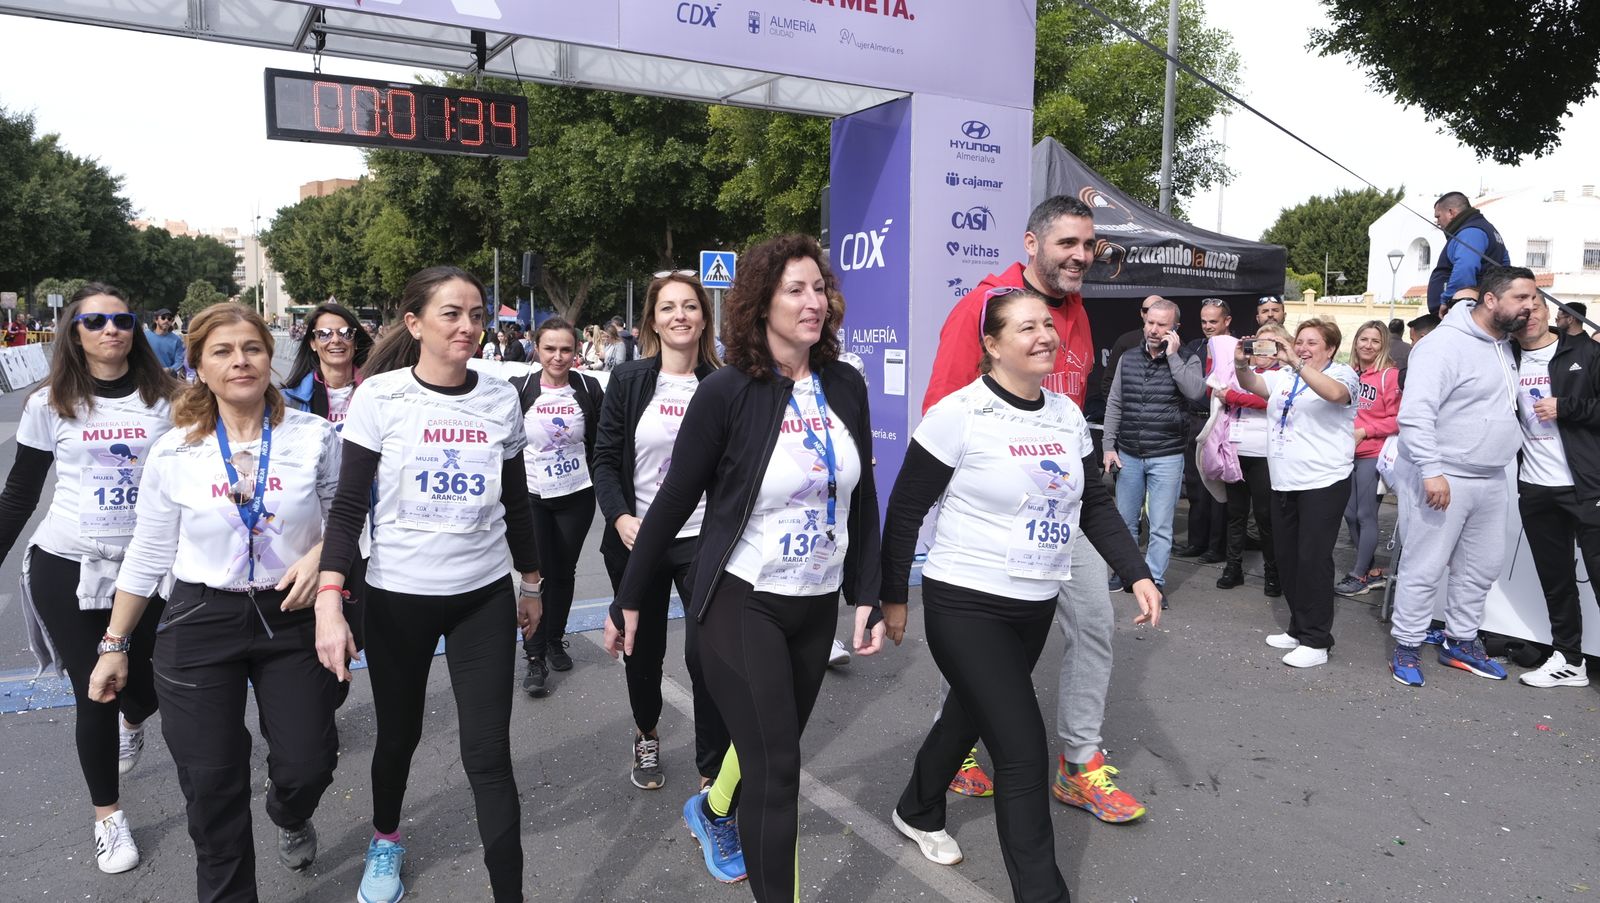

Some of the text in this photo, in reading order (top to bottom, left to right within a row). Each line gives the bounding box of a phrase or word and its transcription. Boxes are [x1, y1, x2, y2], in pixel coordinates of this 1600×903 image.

[676, 2, 721, 28] CDX
[770, 15, 817, 34] ALMERÍA
[769, 27, 794, 38] CIUDAD
[950, 139, 1001, 154] HYUNDAI
[956, 151, 996, 164] Almerialva
[962, 176, 1004, 189] cajamar
[951, 211, 988, 231] CASI
[839, 219, 893, 271] CDX
[962, 244, 1000, 257] vithas
[1162, 266, 1236, 280] cronometraje deportivo
[852, 326, 897, 343] ALMERÍA
[852, 345, 874, 354] CIUDAD
[536, 406, 575, 415] MUJER
[427, 419, 485, 429] CARRERA DE LA
[82, 428, 147, 441] MUJER
[424, 428, 489, 444] MUJER
[261, 440, 269, 456] NEXA
[1008, 443, 1067, 456] MUJER
[544, 457, 580, 477] 1360
[258, 467, 266, 484] NEXA
[415, 470, 486, 496] 1363
[252, 496, 261, 513] NEXA
[431, 494, 467, 502] ARANCHA
[1025, 519, 1071, 544] 1359
